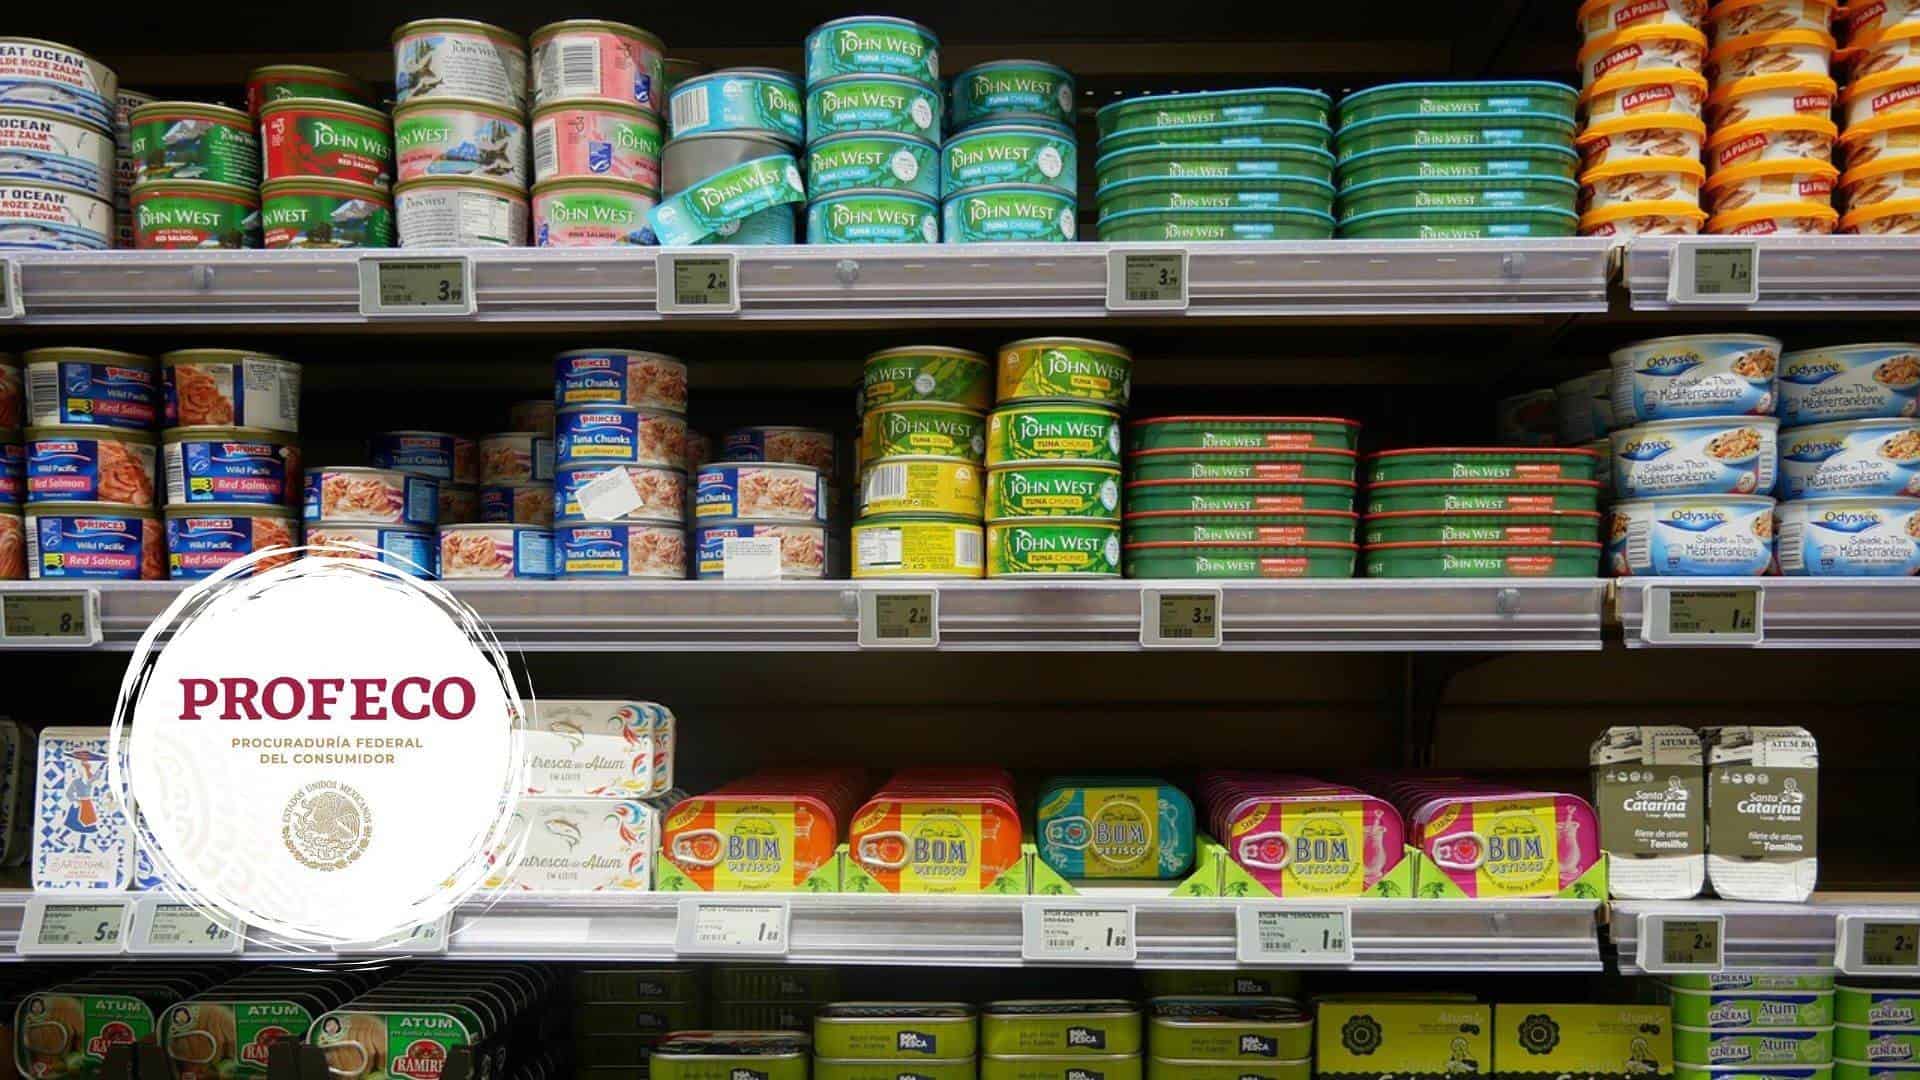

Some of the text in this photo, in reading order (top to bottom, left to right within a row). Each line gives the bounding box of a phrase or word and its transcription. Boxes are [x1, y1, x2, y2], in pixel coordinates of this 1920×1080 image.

[840, 35, 924, 58] JOHN WEST
[32, 48, 83, 69] OCEAN
[1016, 79, 1053, 95] WEST
[823, 92, 907, 116] JOHN WEST
[314, 126, 359, 149] JOHN
[412, 128, 450, 145] WEST
[616, 127, 653, 153] JOHN
[840, 151, 884, 166] WEST
[986, 146, 1031, 161] WEST
[13, 190, 65, 204] OCEAN
[700, 181, 744, 215] JOHN
[141, 207, 221, 231] JOHN WEST
[273, 209, 309, 223] WEST
[550, 204, 635, 224] JOHN WEST
[833, 207, 918, 227] JOHN WEST
[970, 203, 1055, 225] JOHN WEST
[1048, 354, 1091, 377] JOHN
[585, 378, 619, 389] Chunks
[582, 415, 622, 425] PRINCES
[891, 416, 972, 436] JOHN WEST
[1021, 418, 1105, 440] JOHN WEST
[573, 434, 630, 445] Tuna Chunks
[1036, 439, 1060, 448] TUNA
[226, 466, 243, 475] Wild
[49, 479, 85, 490] Salmon
[206, 479, 213, 491] 3
[218, 479, 236, 489] Red
[1011, 476, 1095, 497] JOHN WEST
[1025, 497, 1048, 506] TUNA
[1672, 510, 1723, 524] Odyssée
[1825, 510, 1879, 524] Odyssée
[76, 520, 126, 531] PRINCES
[187, 519, 232, 530] PRINCES
[574, 529, 612, 540] PRINCES
[78, 542, 96, 550] Wild
[1015, 533, 1100, 553] JOHN WEST
[56, 554, 64, 567] 3
[588, 549, 621, 559] Chunks
[1031, 553, 1053, 562] TUNA
[69, 556, 132, 567] Red Salmon
[585, 754, 625, 770] Atum
[1635, 789, 1664, 801] Santa
[1749, 792, 1778, 803] Santa
[1623, 799, 1687, 813] Catarina
[1736, 802, 1802, 815] Catarina
[1095, 822, 1146, 846] BOM
[729, 835, 781, 861] BOM
[913, 837, 968, 864] BOM
[1295, 837, 1350, 864] BOM
[1487, 835, 1545, 863] BOM
[1650, 838, 1688, 849] Tomilho
[1764, 841, 1804, 852] Tomilho
[1096, 845, 1147, 857] PETISCO
[504, 852, 623, 869] Vntresca Atum
[96, 1000, 142, 1013] ATUM
[247, 1004, 300, 1018] ATUM
[1710, 1010, 1751, 1021] GENERAL
[1759, 1002, 1798, 1015] Atum
[1870, 1009, 1913, 1020] GENERAL
[399, 1015, 454, 1030] ATUM
[900, 1039, 928, 1049] PESCA
[1069, 1035, 1097, 1045] PESCA
[1242, 1042, 1270, 1052] PESCA
[1710, 1038, 1799, 1057] GENERAL Atum
[1869, 1045, 1912, 1056] GENERAL
